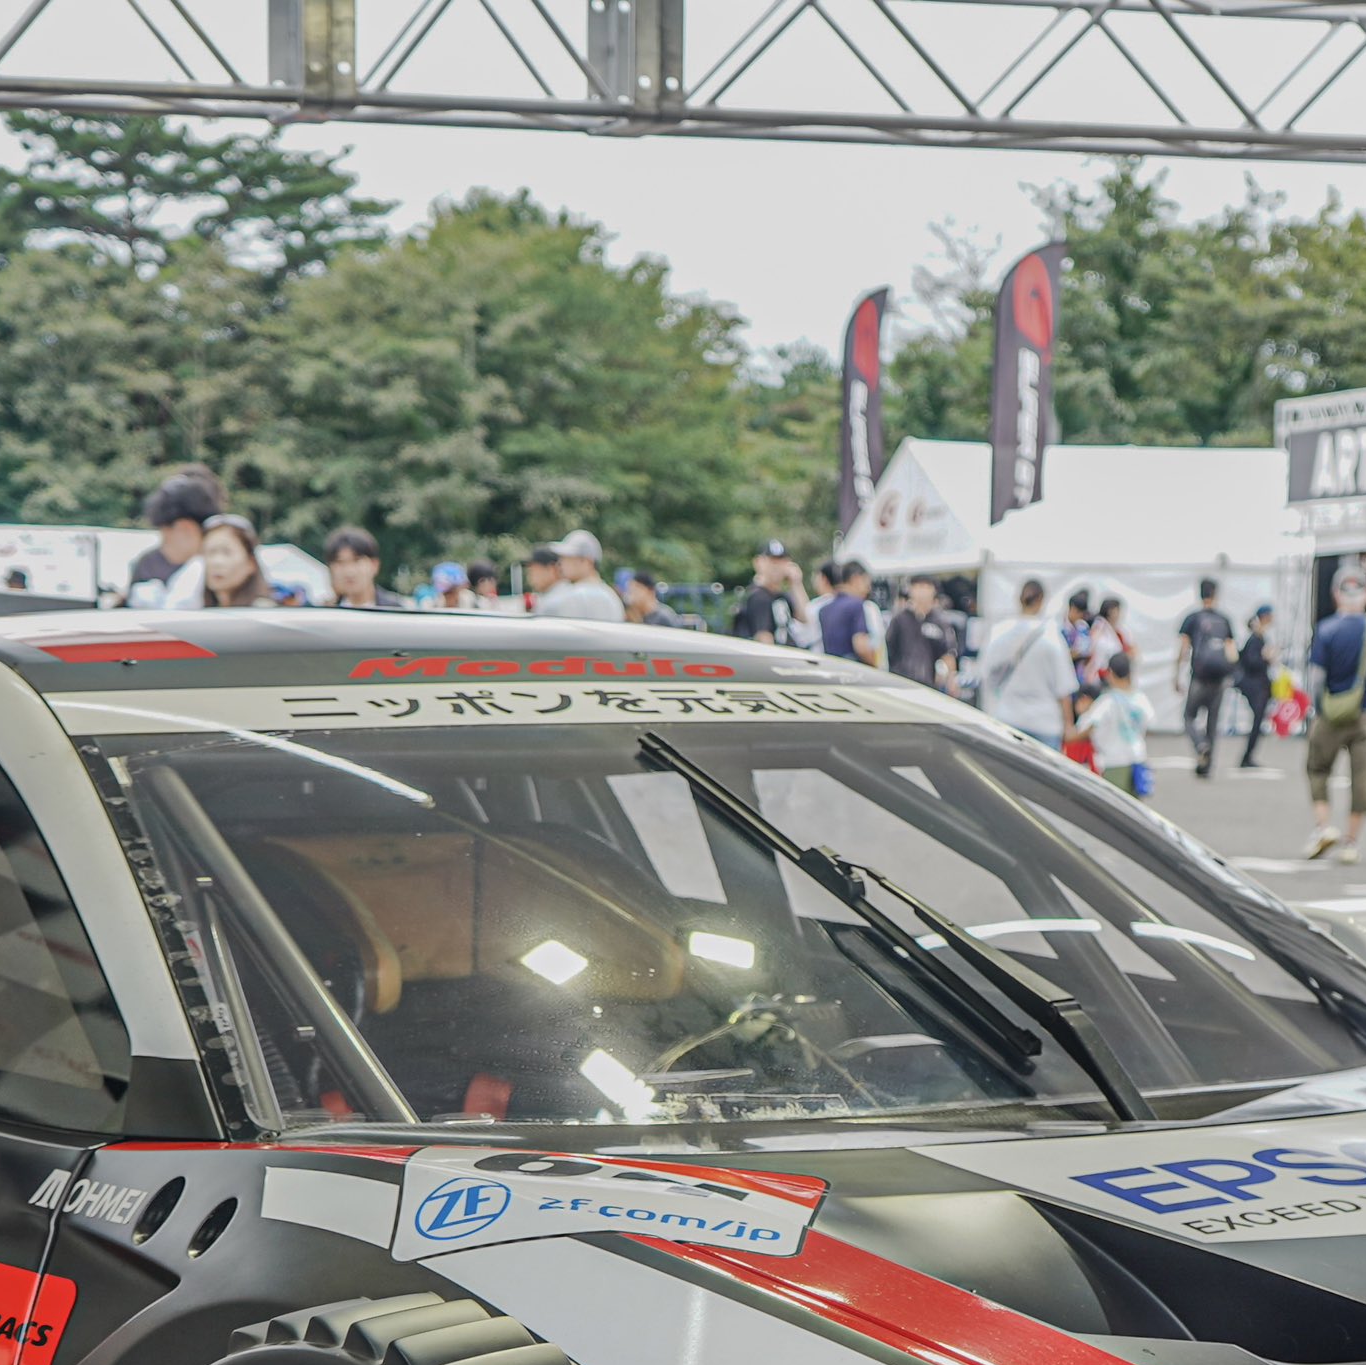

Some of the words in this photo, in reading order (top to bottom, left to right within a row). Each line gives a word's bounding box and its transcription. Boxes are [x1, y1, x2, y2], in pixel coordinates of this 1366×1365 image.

[348, 655, 736, 679] Modulo
[416, 1178, 510, 1239] ZF
[538, 1196, 781, 1241] zf.com/jp
[1182, 1193, 1364, 1236] EXCEED
